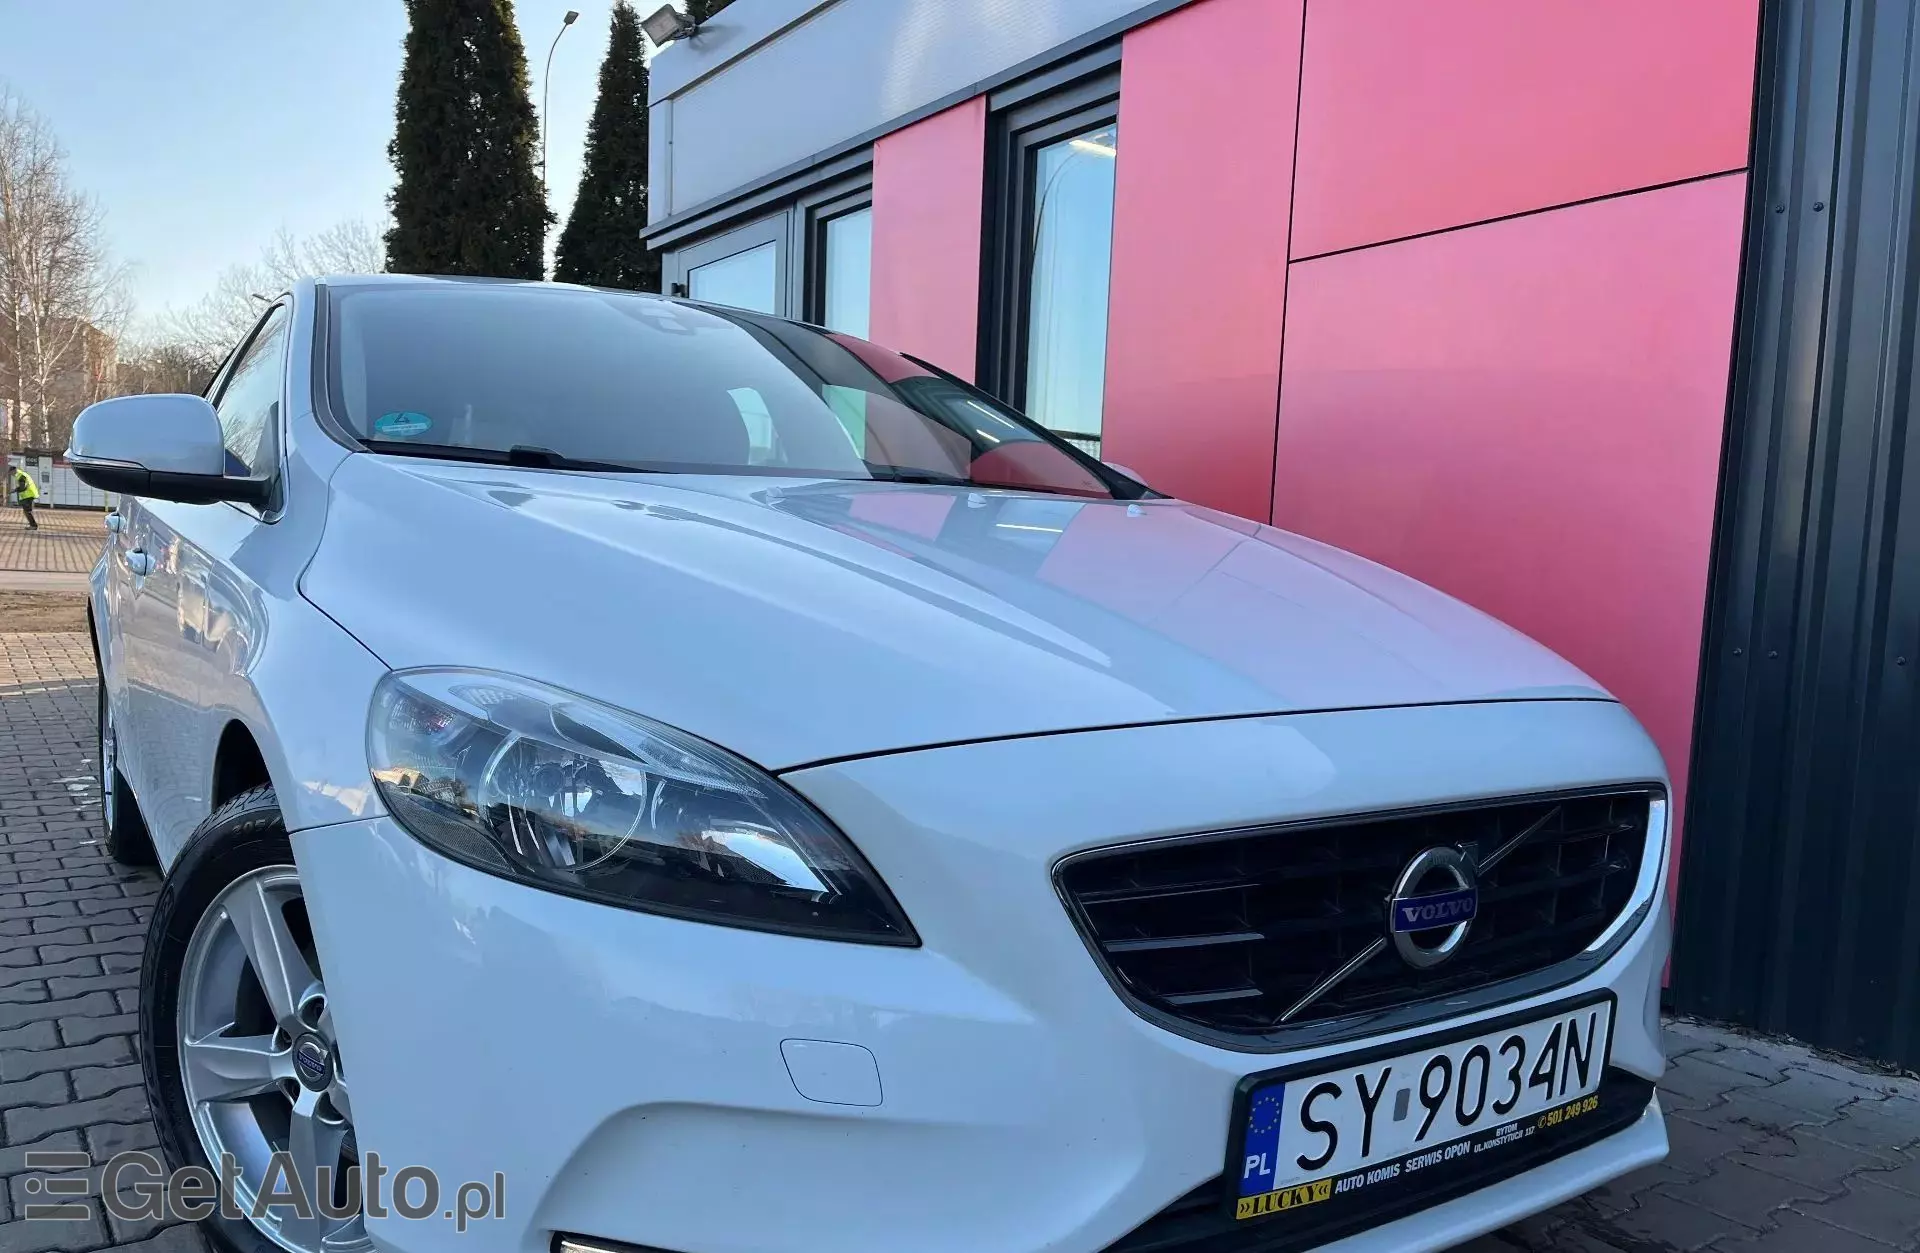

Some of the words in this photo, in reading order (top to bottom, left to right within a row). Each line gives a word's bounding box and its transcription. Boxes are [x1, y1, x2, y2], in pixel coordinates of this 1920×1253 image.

[1402, 897, 1473, 922] VOLVO
[299, 1054, 322, 1072] VOLVO
[1296, 1067, 1392, 1171] SY
[1415, 1012, 1596, 1142] 9034N
[1547, 1110, 1563, 1127] 501
[1565, 1101, 1581, 1121] 249
[1582, 1095, 1599, 1113] 926
[1496, 1123, 1518, 1137] BYTOM
[1244, 1152, 1270, 1179] PL
[1335, 1174, 1365, 1194] AUTO
[1366, 1163, 1401, 1185] KOMIS
[1405, 1149, 1442, 1173] SERWIS
[1444, 1140, 1471, 1160] OPON
